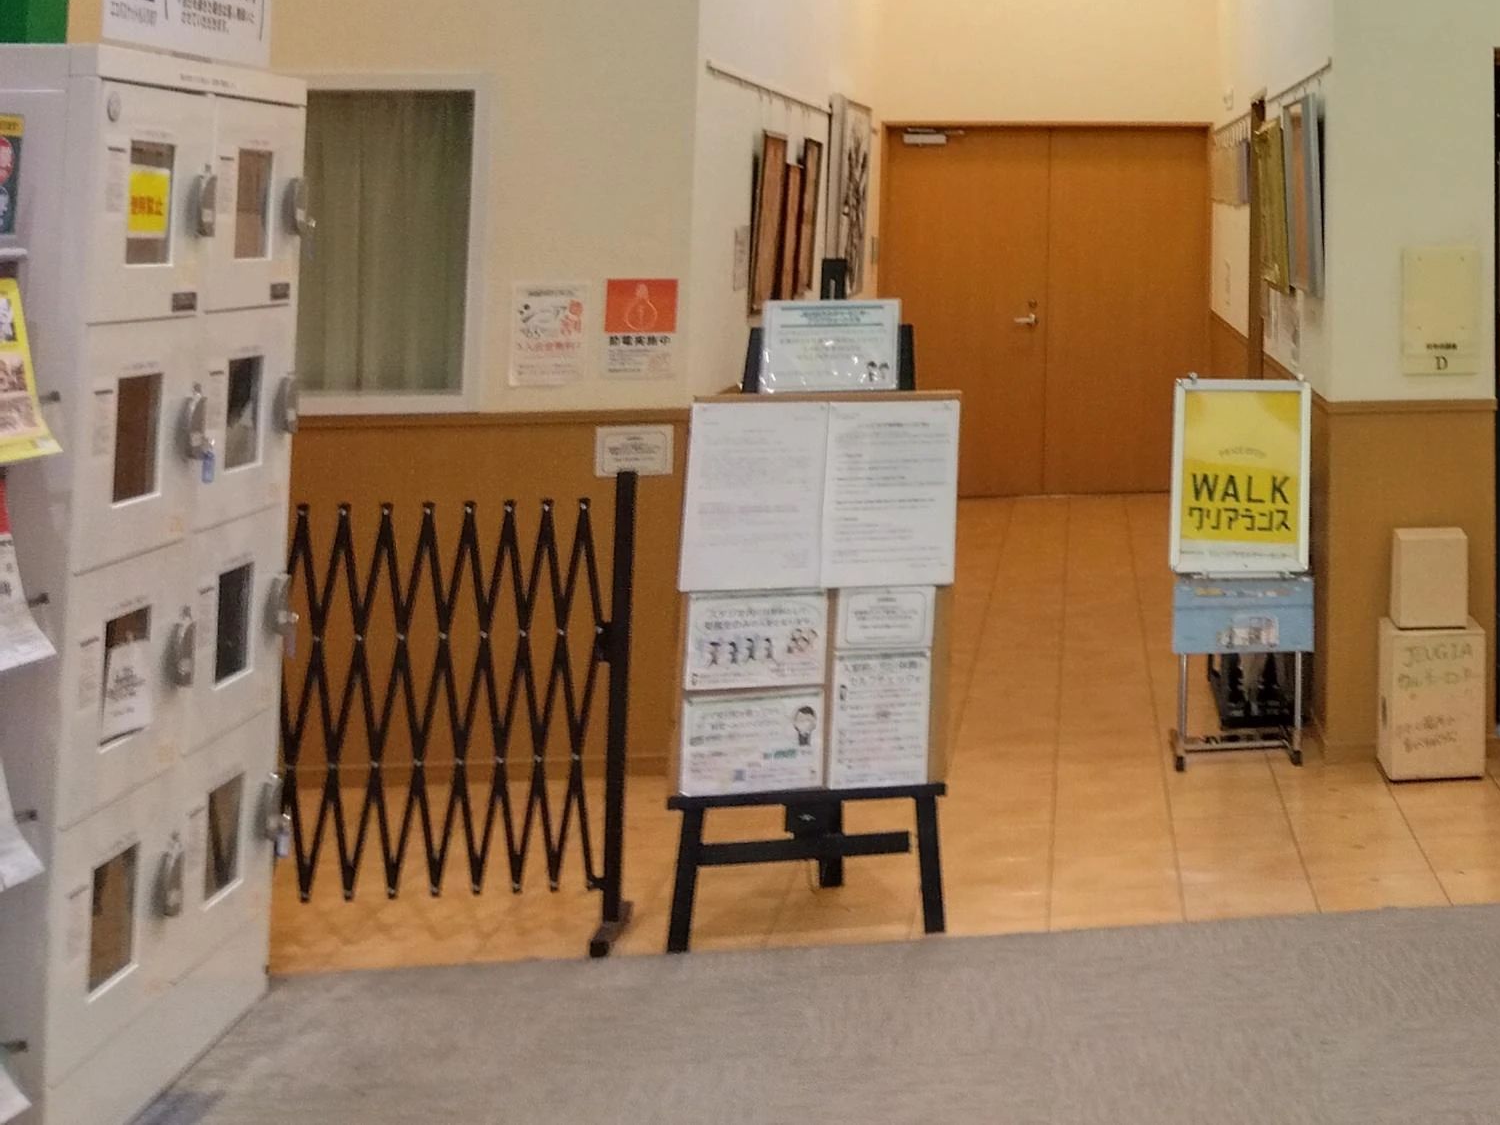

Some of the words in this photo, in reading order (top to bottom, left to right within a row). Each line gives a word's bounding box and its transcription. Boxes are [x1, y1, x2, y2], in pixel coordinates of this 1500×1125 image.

[1432, 354, 1449, 371] D
[1190, 472, 1291, 505] WALK
[1187, 506, 1292, 532] クリアランス
